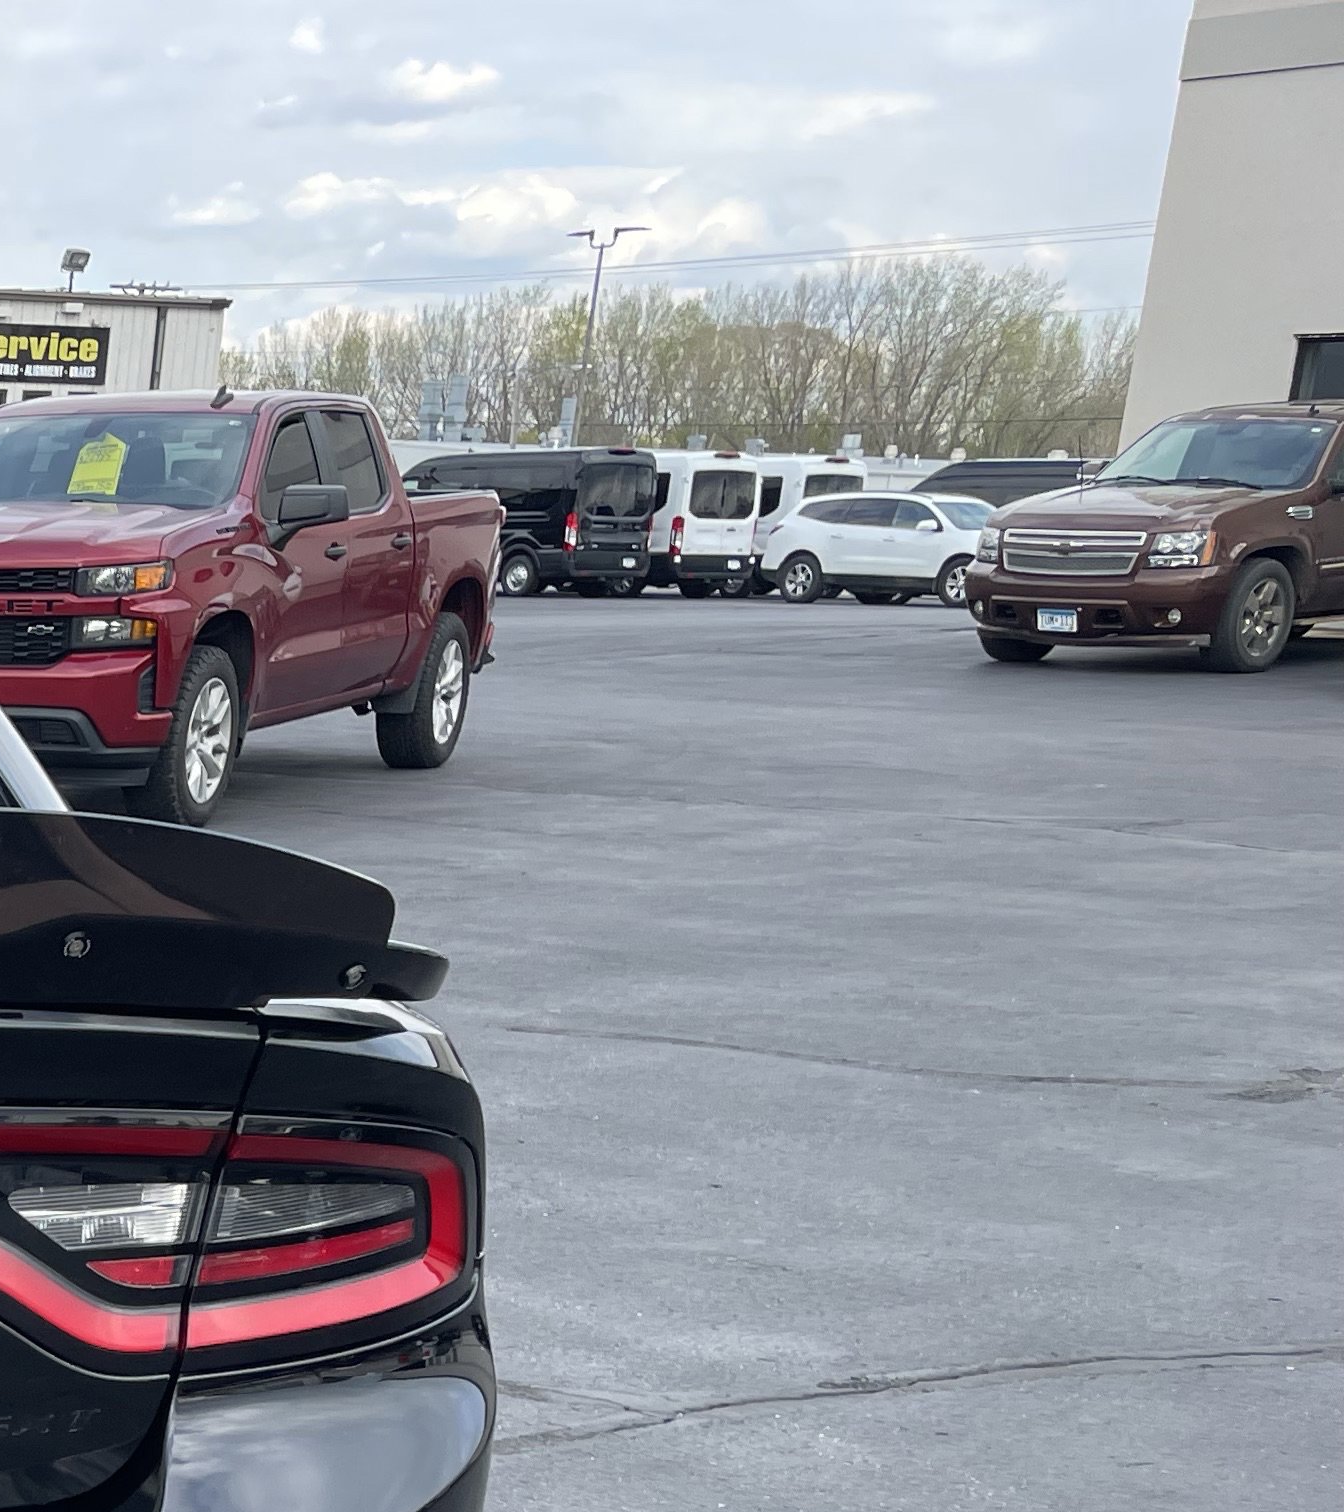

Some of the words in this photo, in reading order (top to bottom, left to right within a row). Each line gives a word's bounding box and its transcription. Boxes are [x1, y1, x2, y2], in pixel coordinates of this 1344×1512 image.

[0, 363, 19, 376] TIRES
[24, 364, 64, 378] ALIGNMENT
[69, 366, 96, 378] BRAKES
